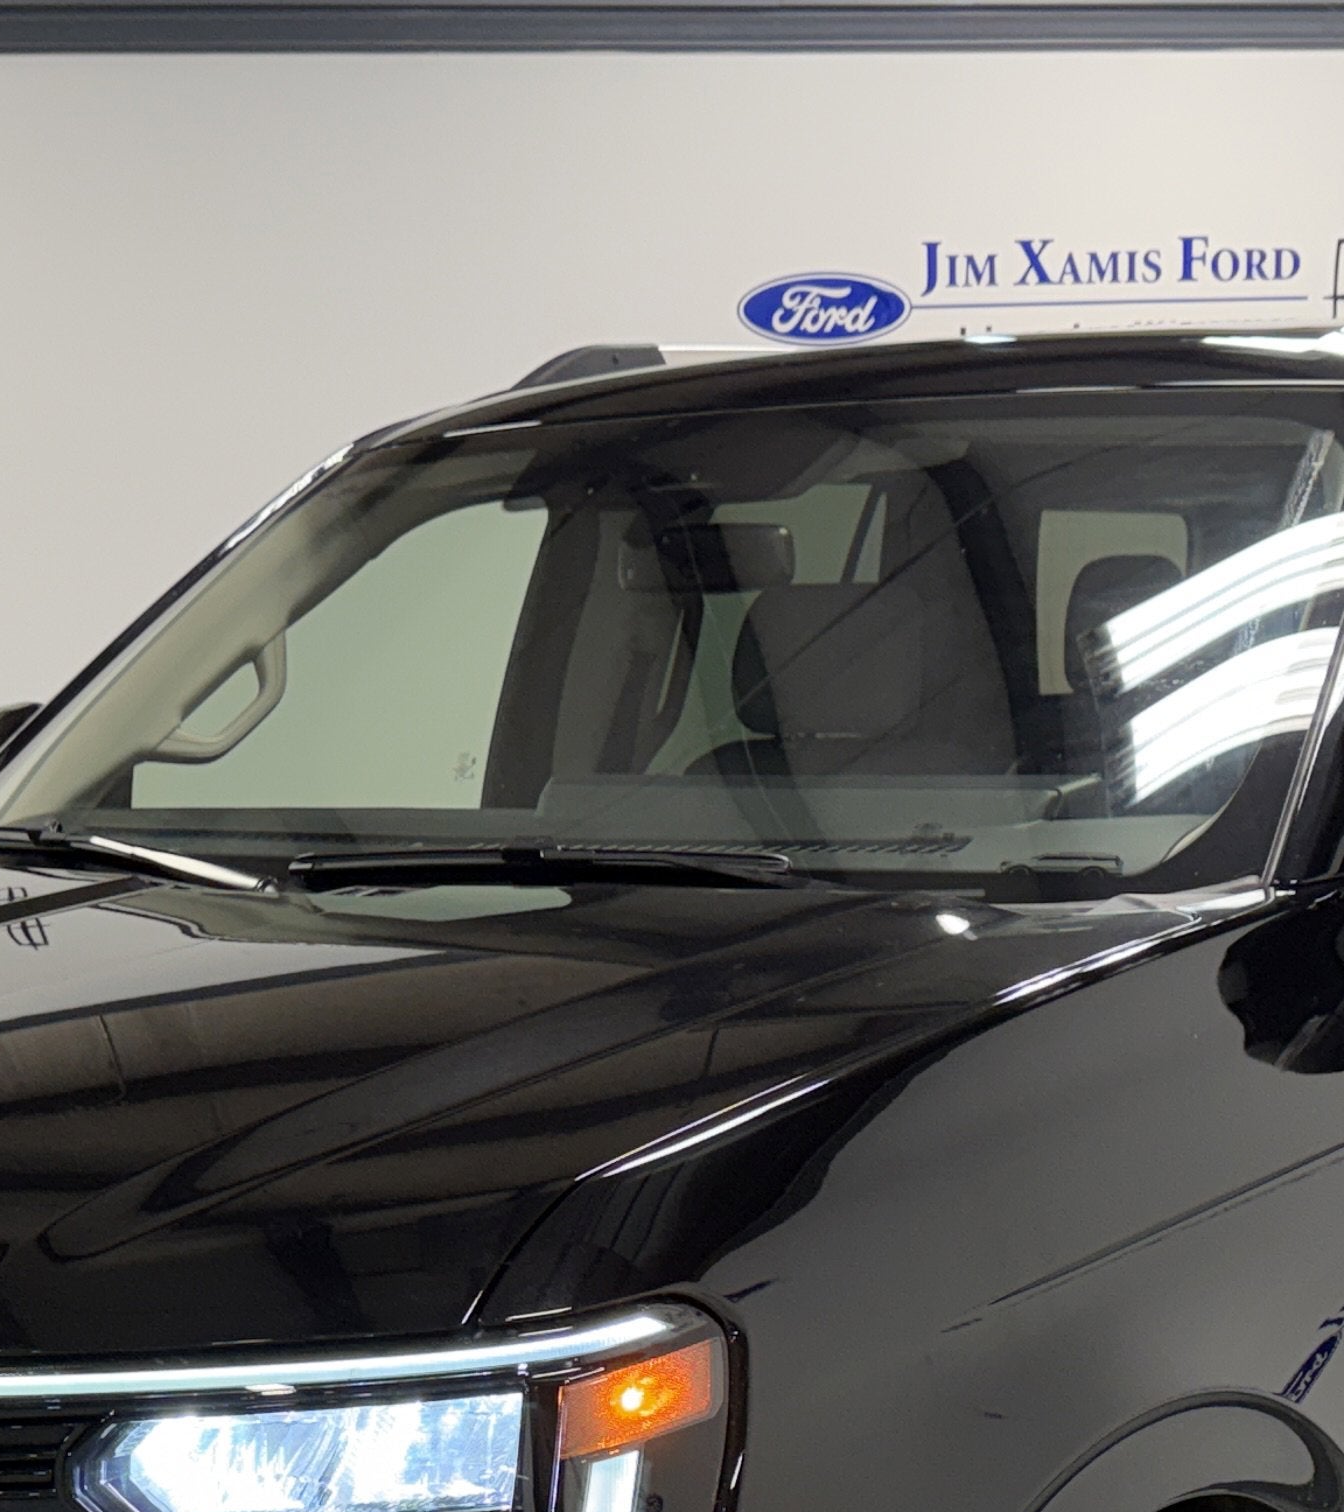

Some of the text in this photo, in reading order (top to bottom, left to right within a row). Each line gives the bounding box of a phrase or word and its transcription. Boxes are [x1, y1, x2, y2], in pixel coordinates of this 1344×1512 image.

[920, 235, 1302, 297] JIM XAMIS FORD
